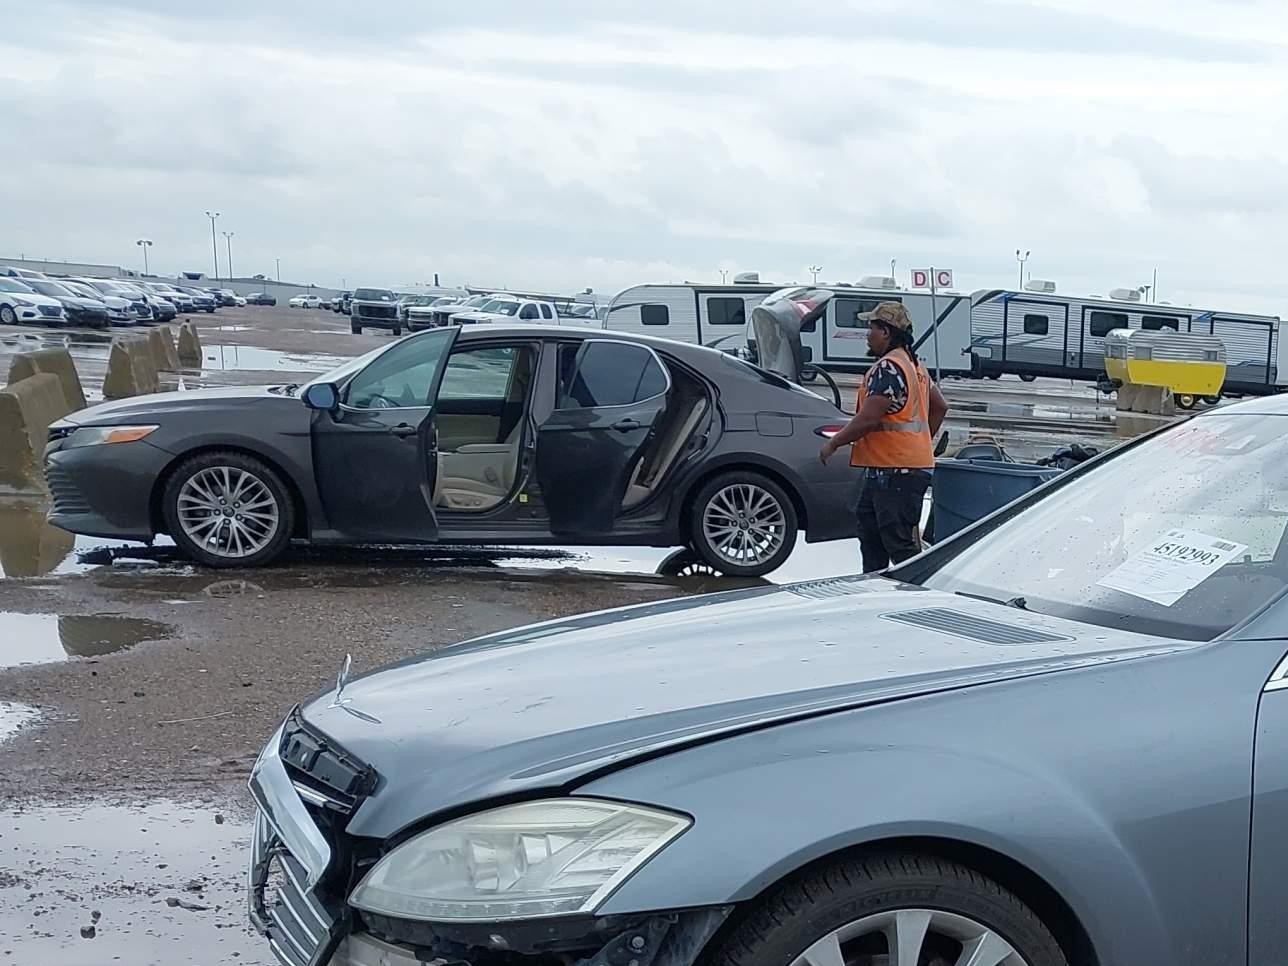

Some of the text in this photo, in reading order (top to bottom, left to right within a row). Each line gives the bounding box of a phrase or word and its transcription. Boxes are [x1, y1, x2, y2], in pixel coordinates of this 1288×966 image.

[914, 271, 926, 286] D
[938, 271, 950, 286] C
[1152, 542, 1221, 566] 45192993
